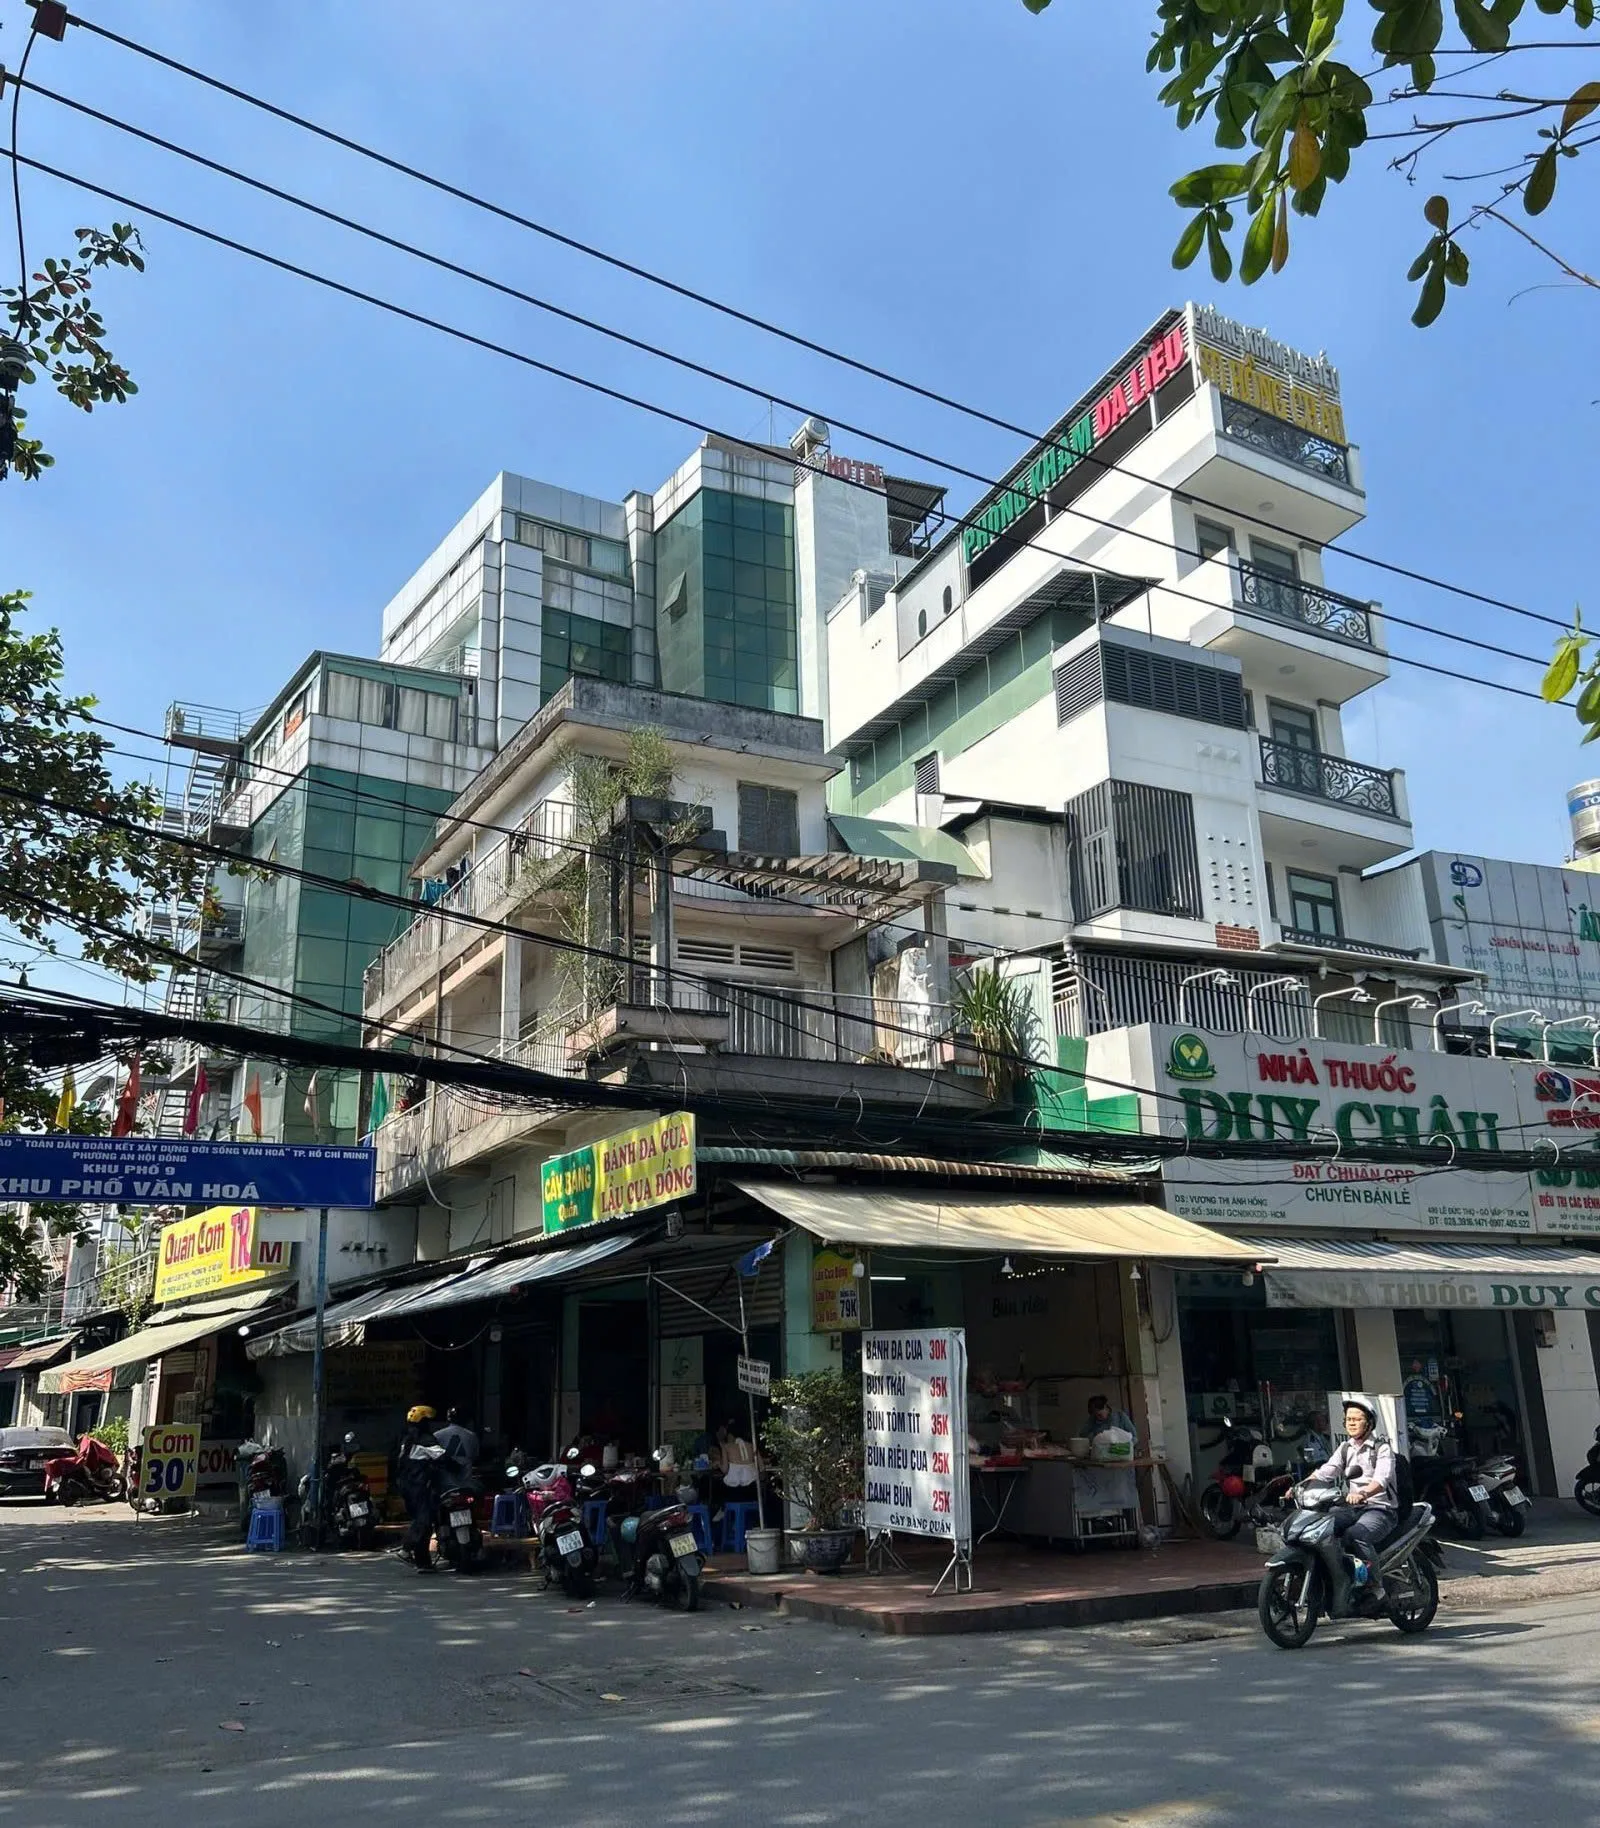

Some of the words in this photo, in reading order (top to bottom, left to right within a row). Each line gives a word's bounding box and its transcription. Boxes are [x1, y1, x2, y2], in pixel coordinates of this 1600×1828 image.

[1094, 381, 1130, 439] DA
[1258, 1048, 1319, 1086] NHÀ
[1322, 1054, 1417, 1094] THUỐC
[1178, 1087, 1320, 1141] DUY
[1335, 1094, 1500, 1152] CHÂU
[72, 1150, 117, 1161] PHƯỜNG
[137, 1153, 155, 1162] HỘI
[115, 1141, 134, 1151] KẾT
[137, 1142, 158, 1152] XÂY
[212, 1144, 240, 1155] SỐNG
[309, 1149, 322, 1158] HỒ
[324, 1150, 341, 1159] CHÍ
[343, 1152, 368, 1160] MINH
[603, 1138, 635, 1173] BÁNH
[639, 1134, 657, 1160] ĐA
[660, 1123, 689, 1153] CUA
[83, 1163, 119, 1175] KHU
[124, 1162, 160, 1175] PHỐ
[165, 1166, 176, 1176] 9
[1292, 1163, 1322, 1181] ĐẠT
[61, 1176, 125, 1196] PHỐ
[133, 1179, 193, 1198] VĂN
[202, 1182, 260, 1199] HOÁ
[544, 1170, 562, 1203] CÂY
[601, 1175, 624, 1213] LẨU
[626, 1177, 653, 1205] CUA
[655, 1159, 694, 1197] ĐỒNG
[1305, 1185, 1365, 1205] CHUYÊN
[1379, 1277, 1478, 1305] THUỐC
[1490, 1284, 1573, 1307] DUY
[840, 1299, 857, 1318] 79K
[866, 1336, 890, 1361] BÁNH
[891, 1339, 903, 1361] ĐA
[905, 1341, 923, 1361] CUA
[929, 1339, 947, 1361] 30K
[866, 1373, 884, 1395] BÚN
[886, 1371, 906, 1397] THÁI
[930, 1376, 948, 1398] 35K
[866, 1408, 884, 1431] BÚN
[886, 1411, 906, 1434] TÔM
[907, 1407, 921, 1434] TÍT
[931, 1414, 949, 1436] 35K
[867, 1445, 886, 1468] BÚN
[888, 1443, 907, 1470] RIÊU
[910, 1450, 928, 1472] CUA
[932, 1452, 950, 1474] 25K
[867, 1481, 891, 1503] CANH
[893, 1482, 912, 1508] BÚN
[933, 1491, 951, 1514] 25K
[890, 1511, 906, 1526] CÂY
[906, 1514, 928, 1531] BÀNG
[928, 1517, 951, 1534] QUÁN
